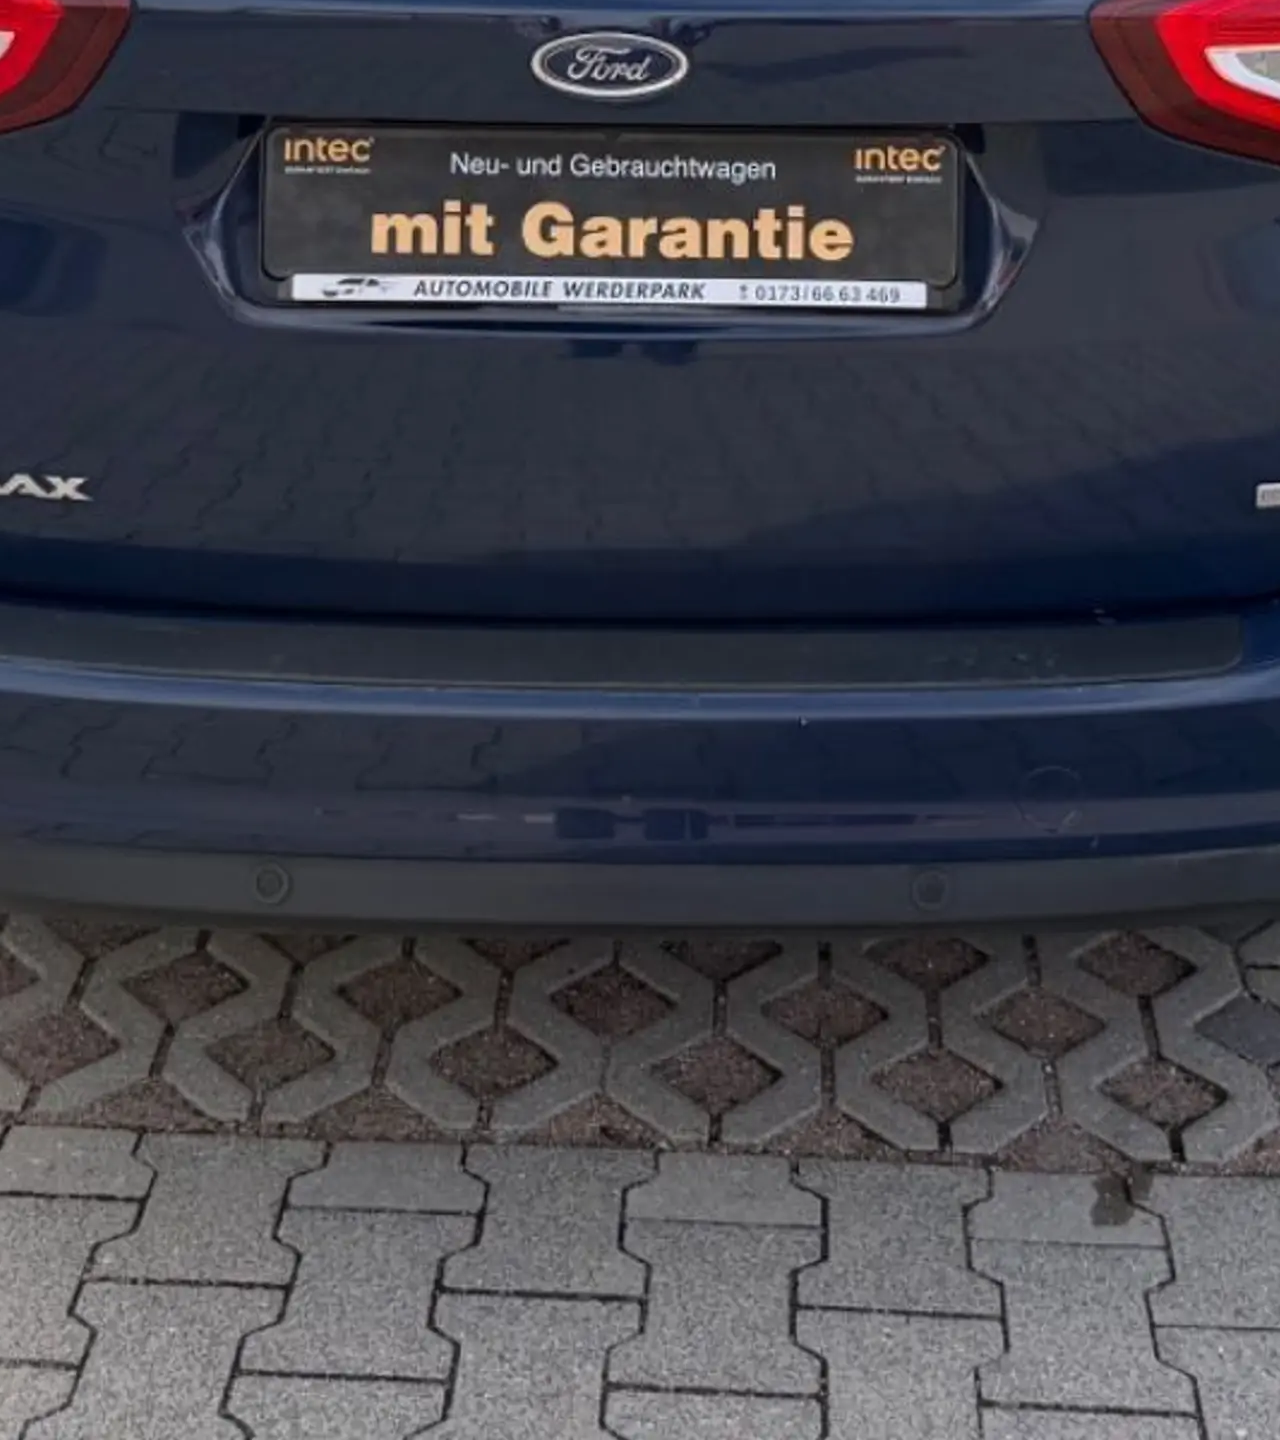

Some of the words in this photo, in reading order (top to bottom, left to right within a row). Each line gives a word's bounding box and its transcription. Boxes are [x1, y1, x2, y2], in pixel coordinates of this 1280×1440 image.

[567, 43, 651, 81] Ford
[283, 137, 376, 163] intec
[854, 145, 946, 172] intec
[450, 152, 509, 175] Neu-
[517, 154, 562, 176] und
[570, 152, 777, 186] Gebrauchtwagen
[370, 199, 496, 256] mit
[521, 200, 855, 261] Garantie
[413, 280, 554, 299] AUTOMOBILE
[562, 281, 707, 300] WERDERPARK
